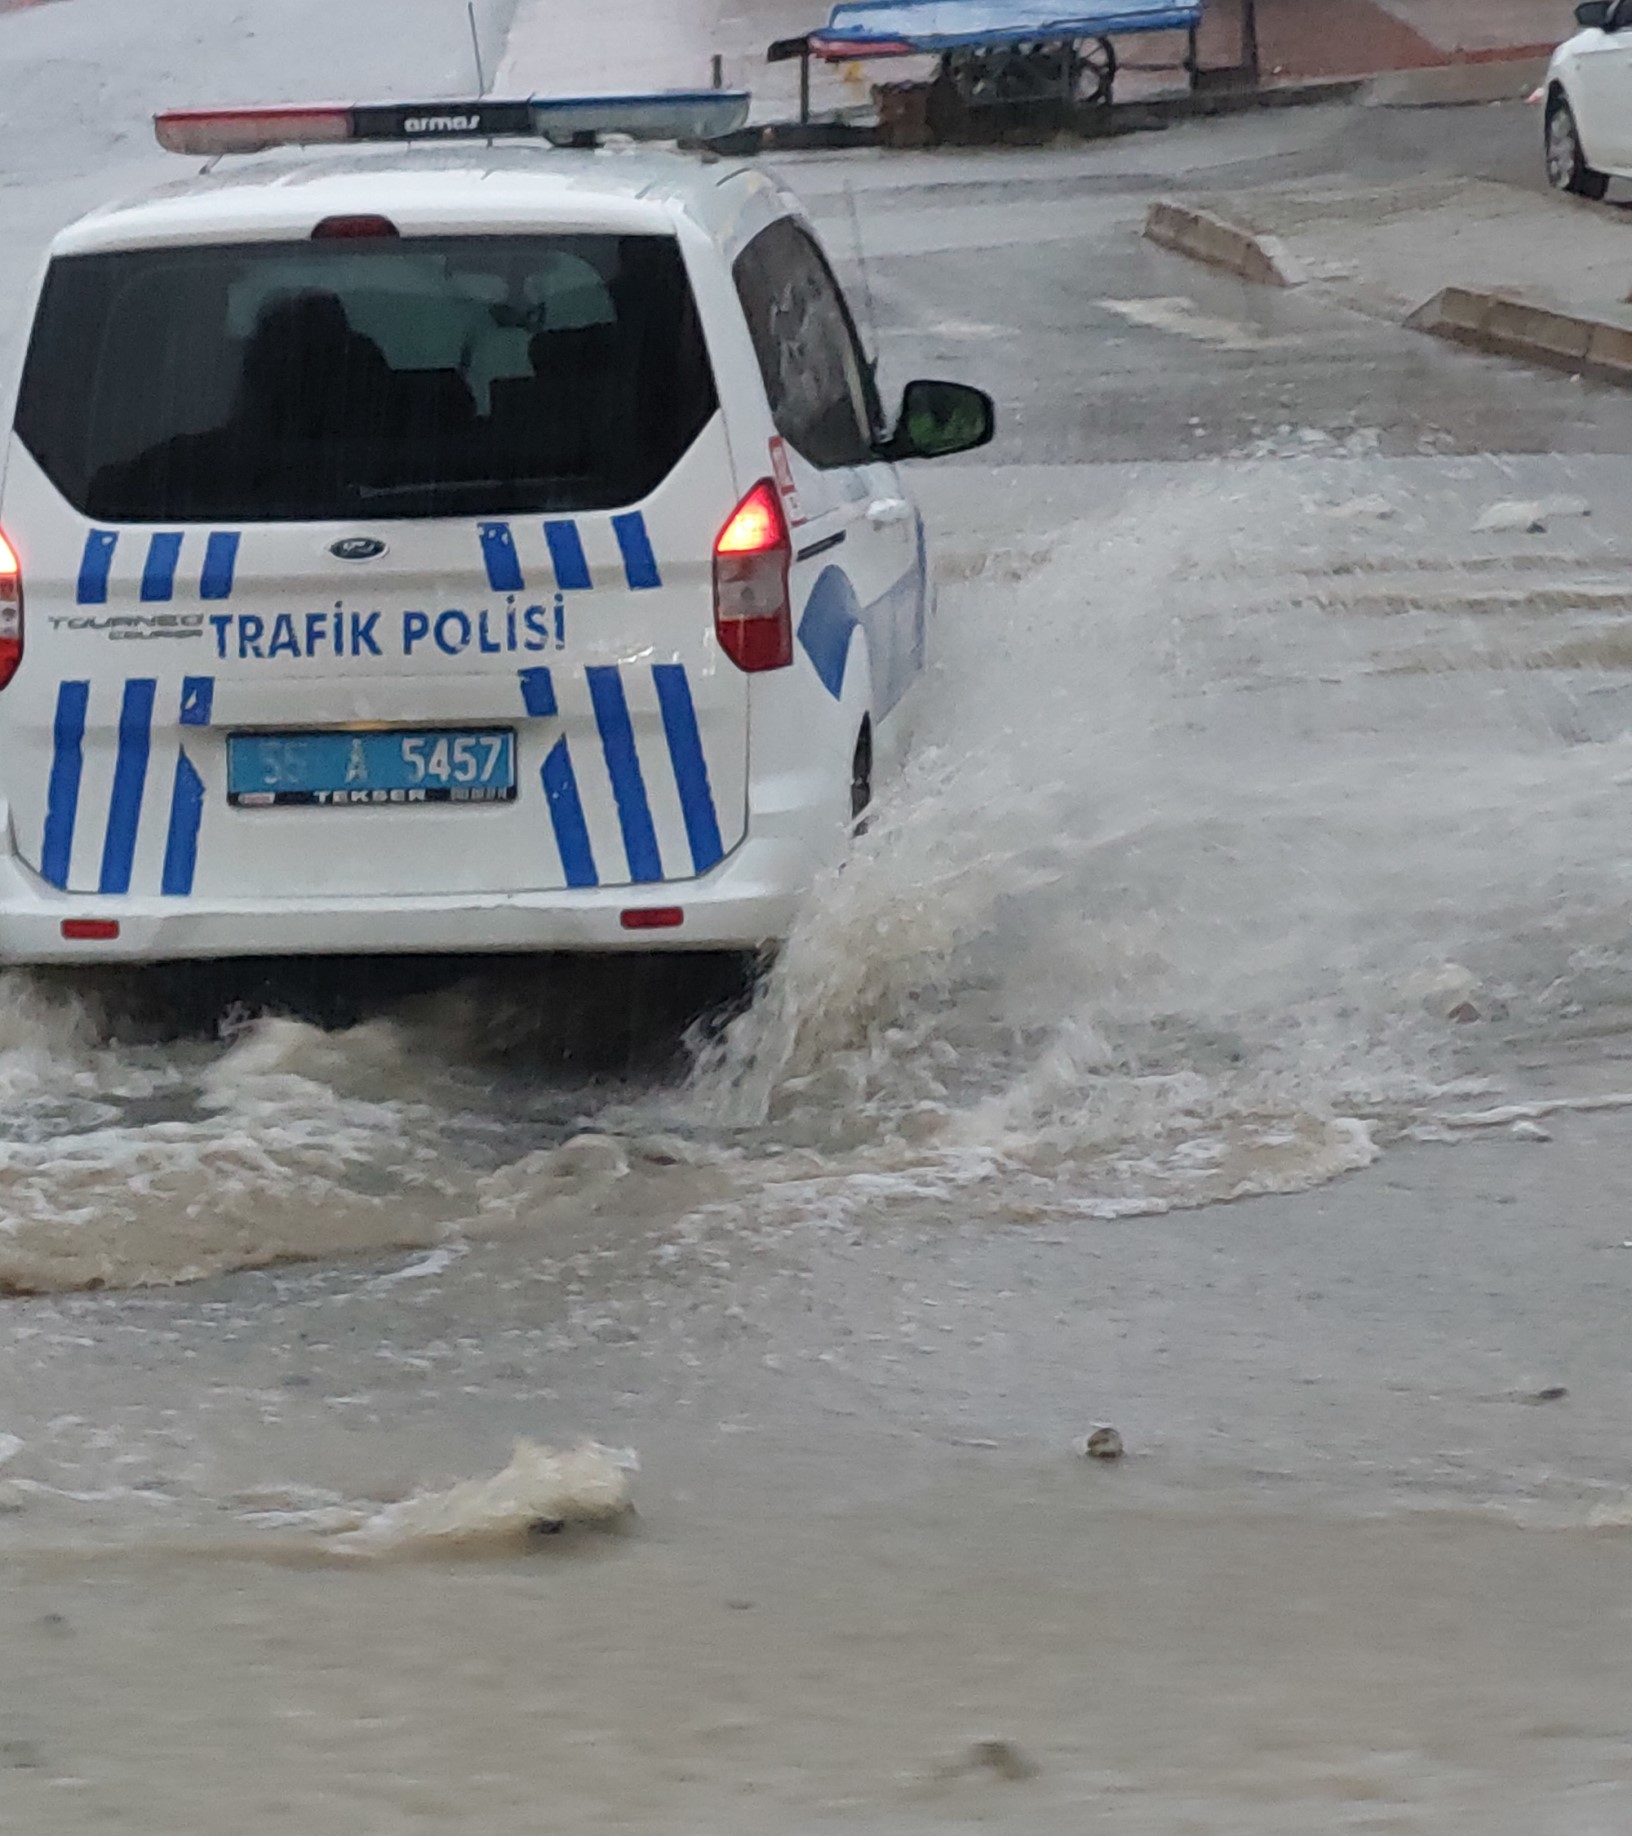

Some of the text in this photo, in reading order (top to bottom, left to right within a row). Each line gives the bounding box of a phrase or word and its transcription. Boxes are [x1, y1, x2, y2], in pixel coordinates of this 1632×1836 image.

[404, 115, 480, 132] armas
[209, 594, 566, 659] TRAFİK POLİSİ
[344, 738, 368, 783] A
[402, 736, 502, 783] 5457
